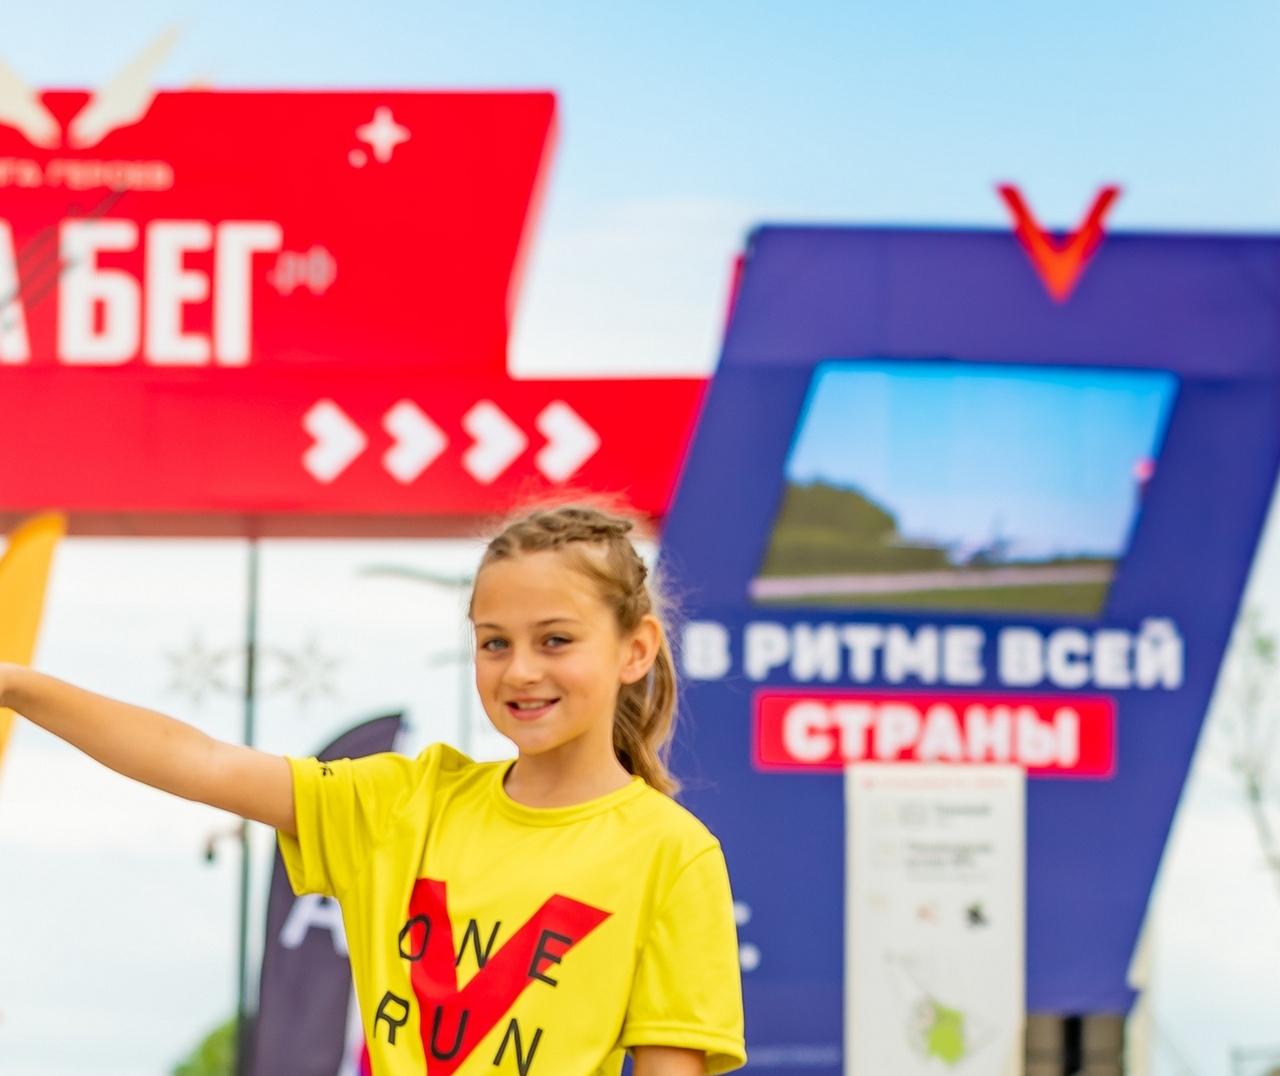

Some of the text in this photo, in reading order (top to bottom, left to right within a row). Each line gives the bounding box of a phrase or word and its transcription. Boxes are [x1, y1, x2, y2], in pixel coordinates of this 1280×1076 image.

[57, 218, 284, 366] БЕГ
[682, 617, 1184, 690] В РИТМЕ ВСЕЙ
[782, 699, 1080, 768] СТРАНЫ
[398, 914, 573, 987] ONE
